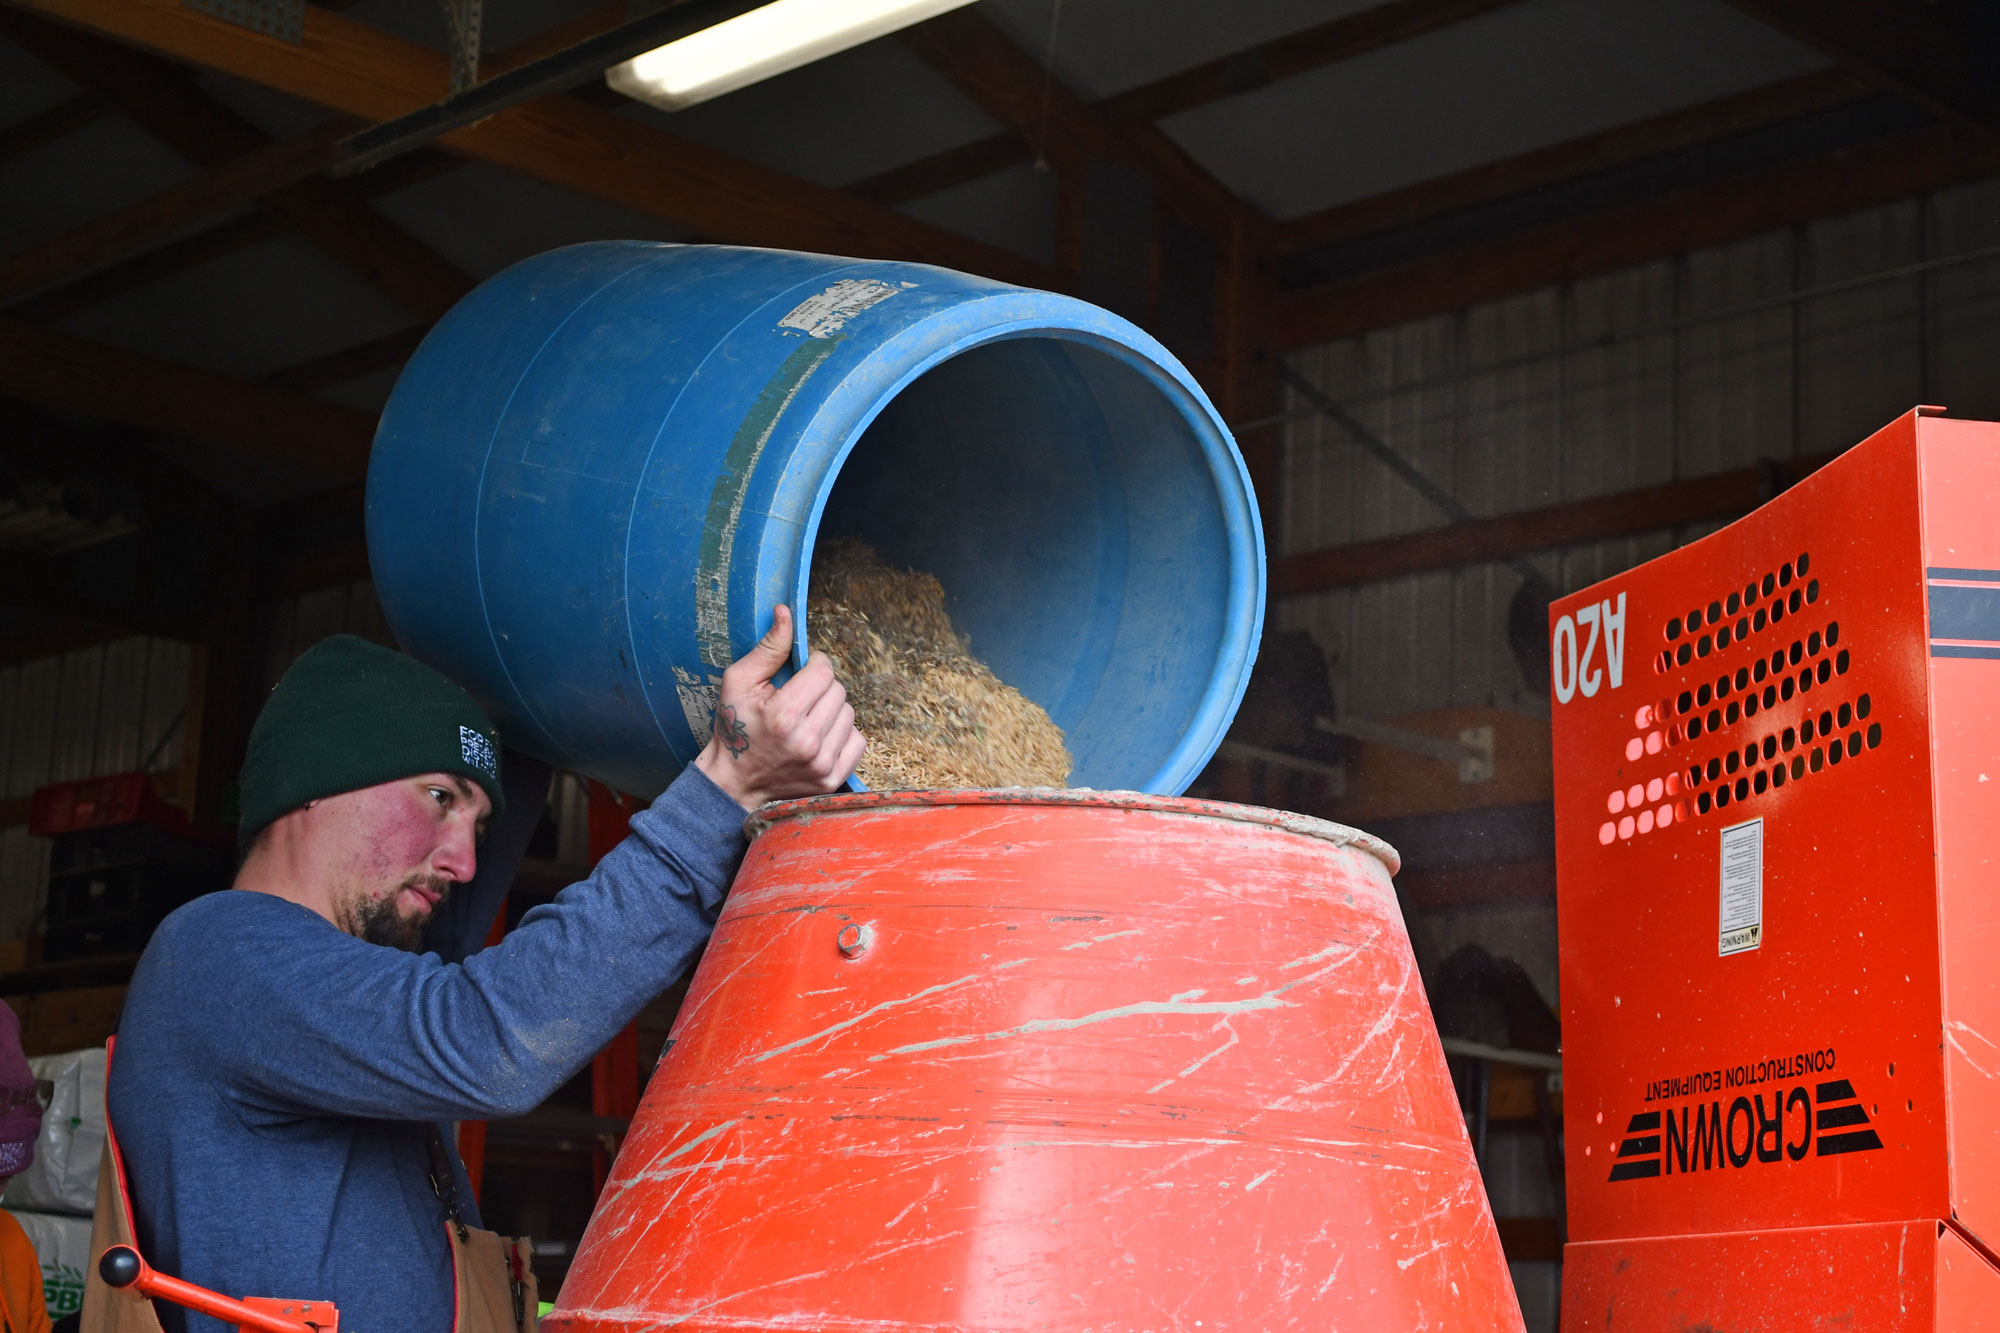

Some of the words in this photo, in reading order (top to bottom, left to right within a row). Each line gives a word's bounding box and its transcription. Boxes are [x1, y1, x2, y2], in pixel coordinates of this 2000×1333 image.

[1553, 591, 1626, 704] A20
[1722, 931, 1750, 948] WARNING
[1645, 1070, 1721, 1102] EQUIPMENT
[1726, 1048, 1836, 1089] CONSTRUCTION
[1666, 1086, 1812, 1175] CROWN
[44, 1288, 84, 1311] PB
